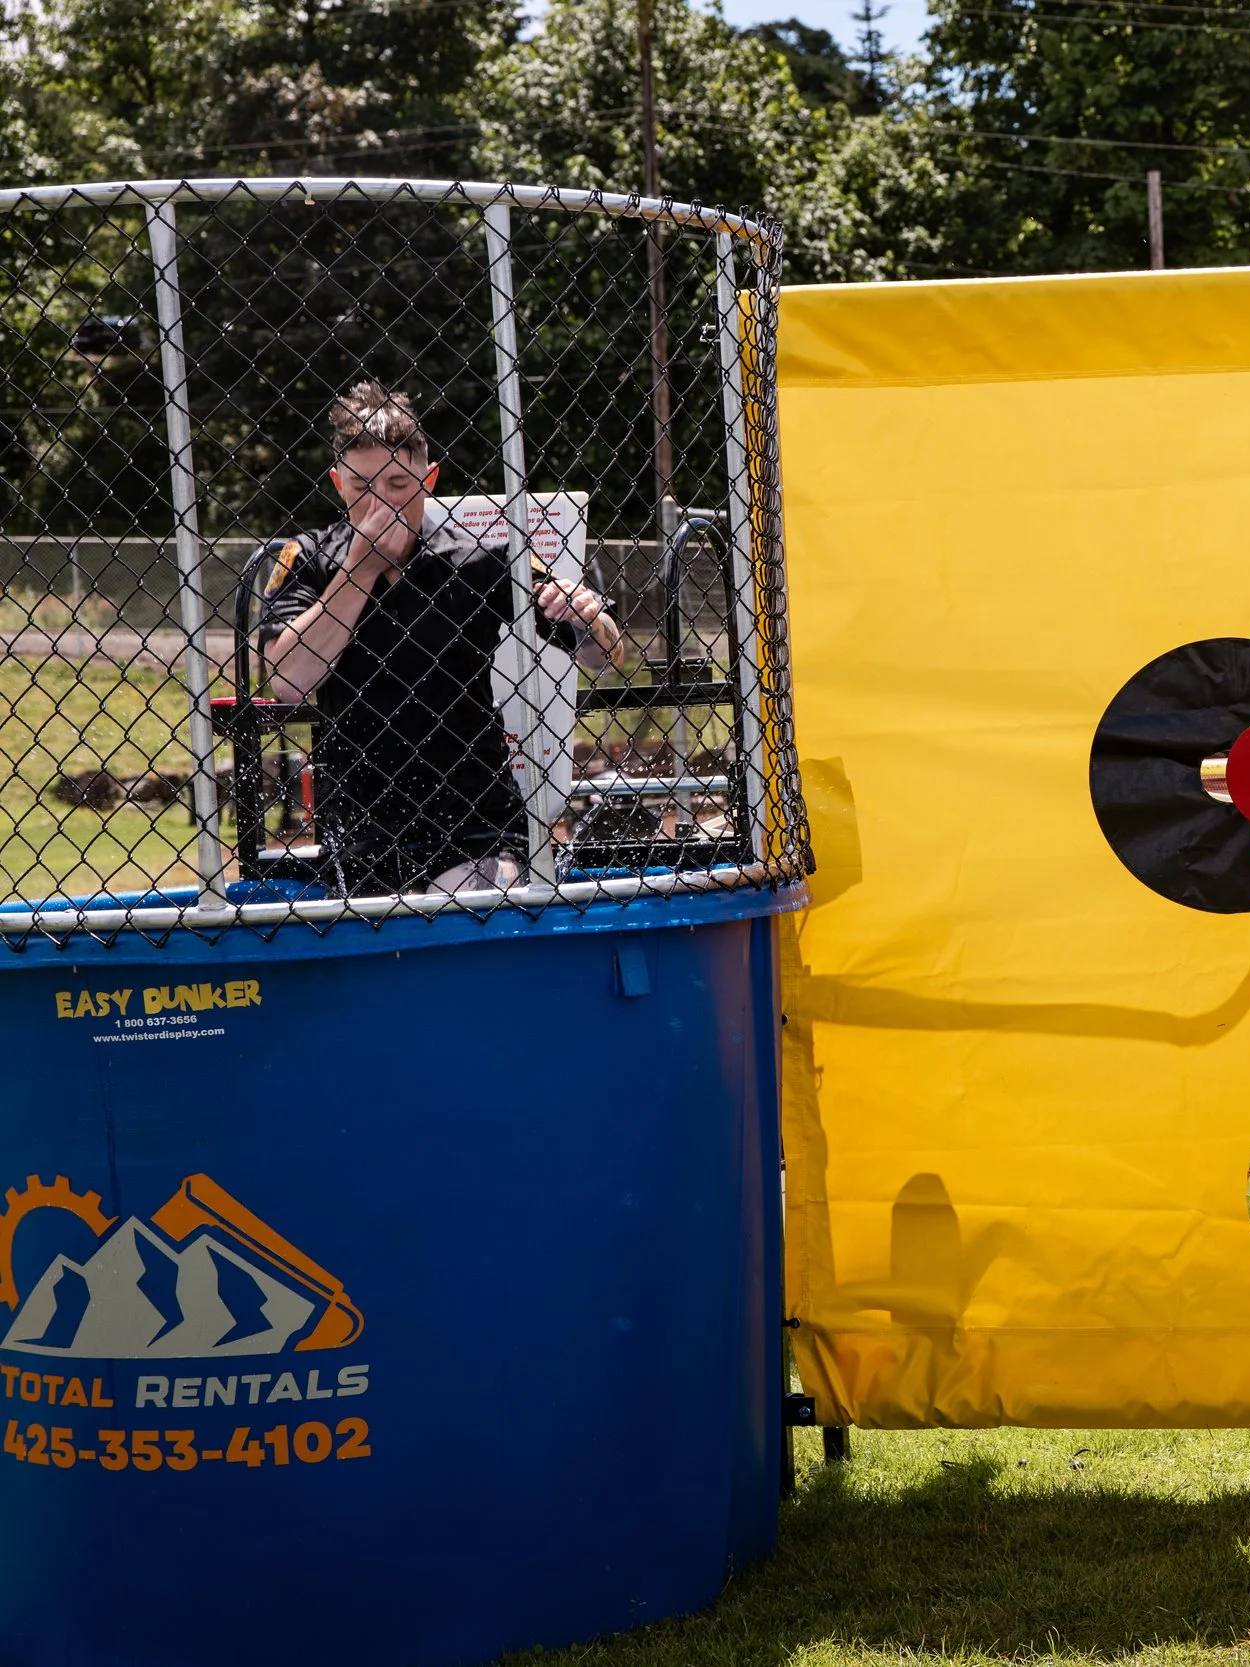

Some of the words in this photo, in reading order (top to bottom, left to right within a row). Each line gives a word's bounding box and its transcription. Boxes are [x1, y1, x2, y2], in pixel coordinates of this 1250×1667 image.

[453, 521, 480, 529] engagd
[55, 988, 134, 1019] EASY
[142, 979, 263, 1015] DUNKER
[93, 1027, 225, 1043] www.twisterdisplay.com
[115, 1020, 121, 1028] 1
[124, 1018, 144, 1028] 800
[146, 1015, 198, 1027] 637-3656
[1, 1363, 115, 1408] TOTAL
[135, 1363, 370, 1408] RENTALS
[3, 1416, 372, 1472] 425-353-4102
